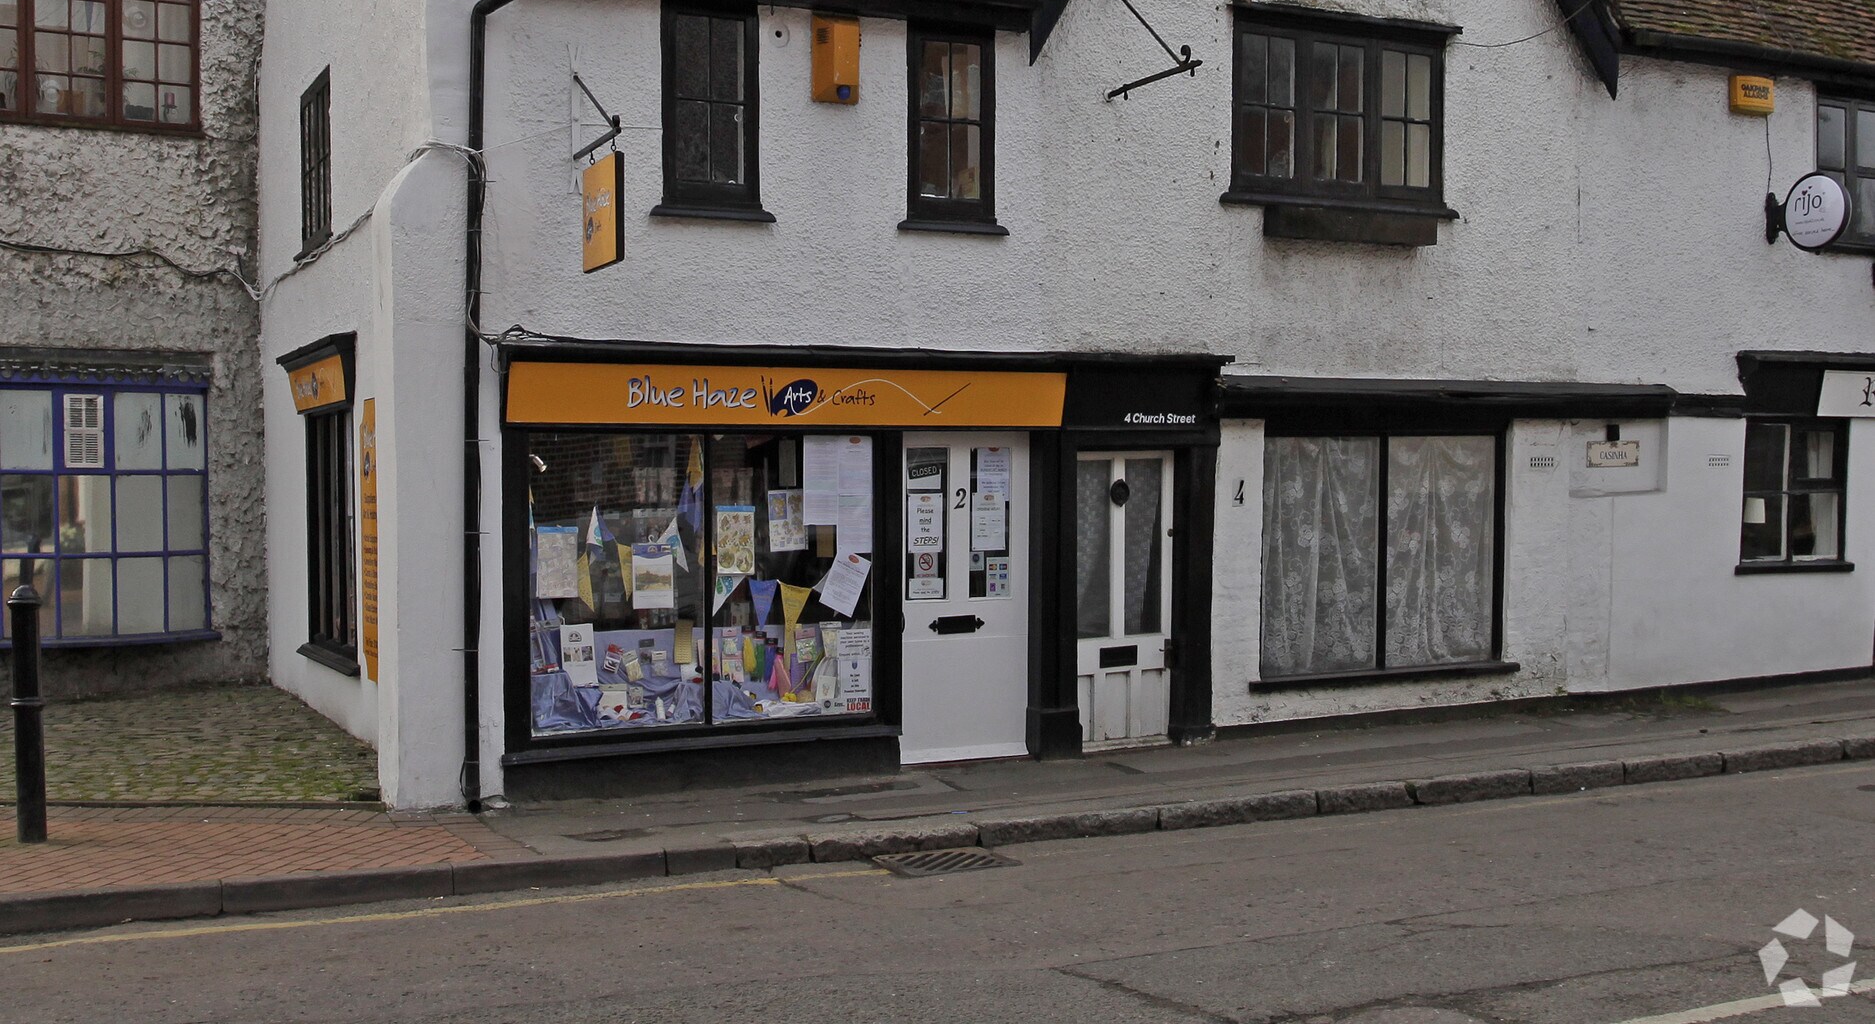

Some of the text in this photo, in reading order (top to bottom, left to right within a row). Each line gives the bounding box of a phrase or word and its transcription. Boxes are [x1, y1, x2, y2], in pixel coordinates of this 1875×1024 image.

[626, 375, 757, 409] Blue Haze
[783, 382, 876, 406] Arts & Crafts
[1124, 412, 1196, 424] 4 Church Street
[911, 465, 938, 477] CLOSED
[954, 487, 967, 509] 2
[1234, 479, 1245, 504] 4
[846, 702, 871, 711] LOCAL
